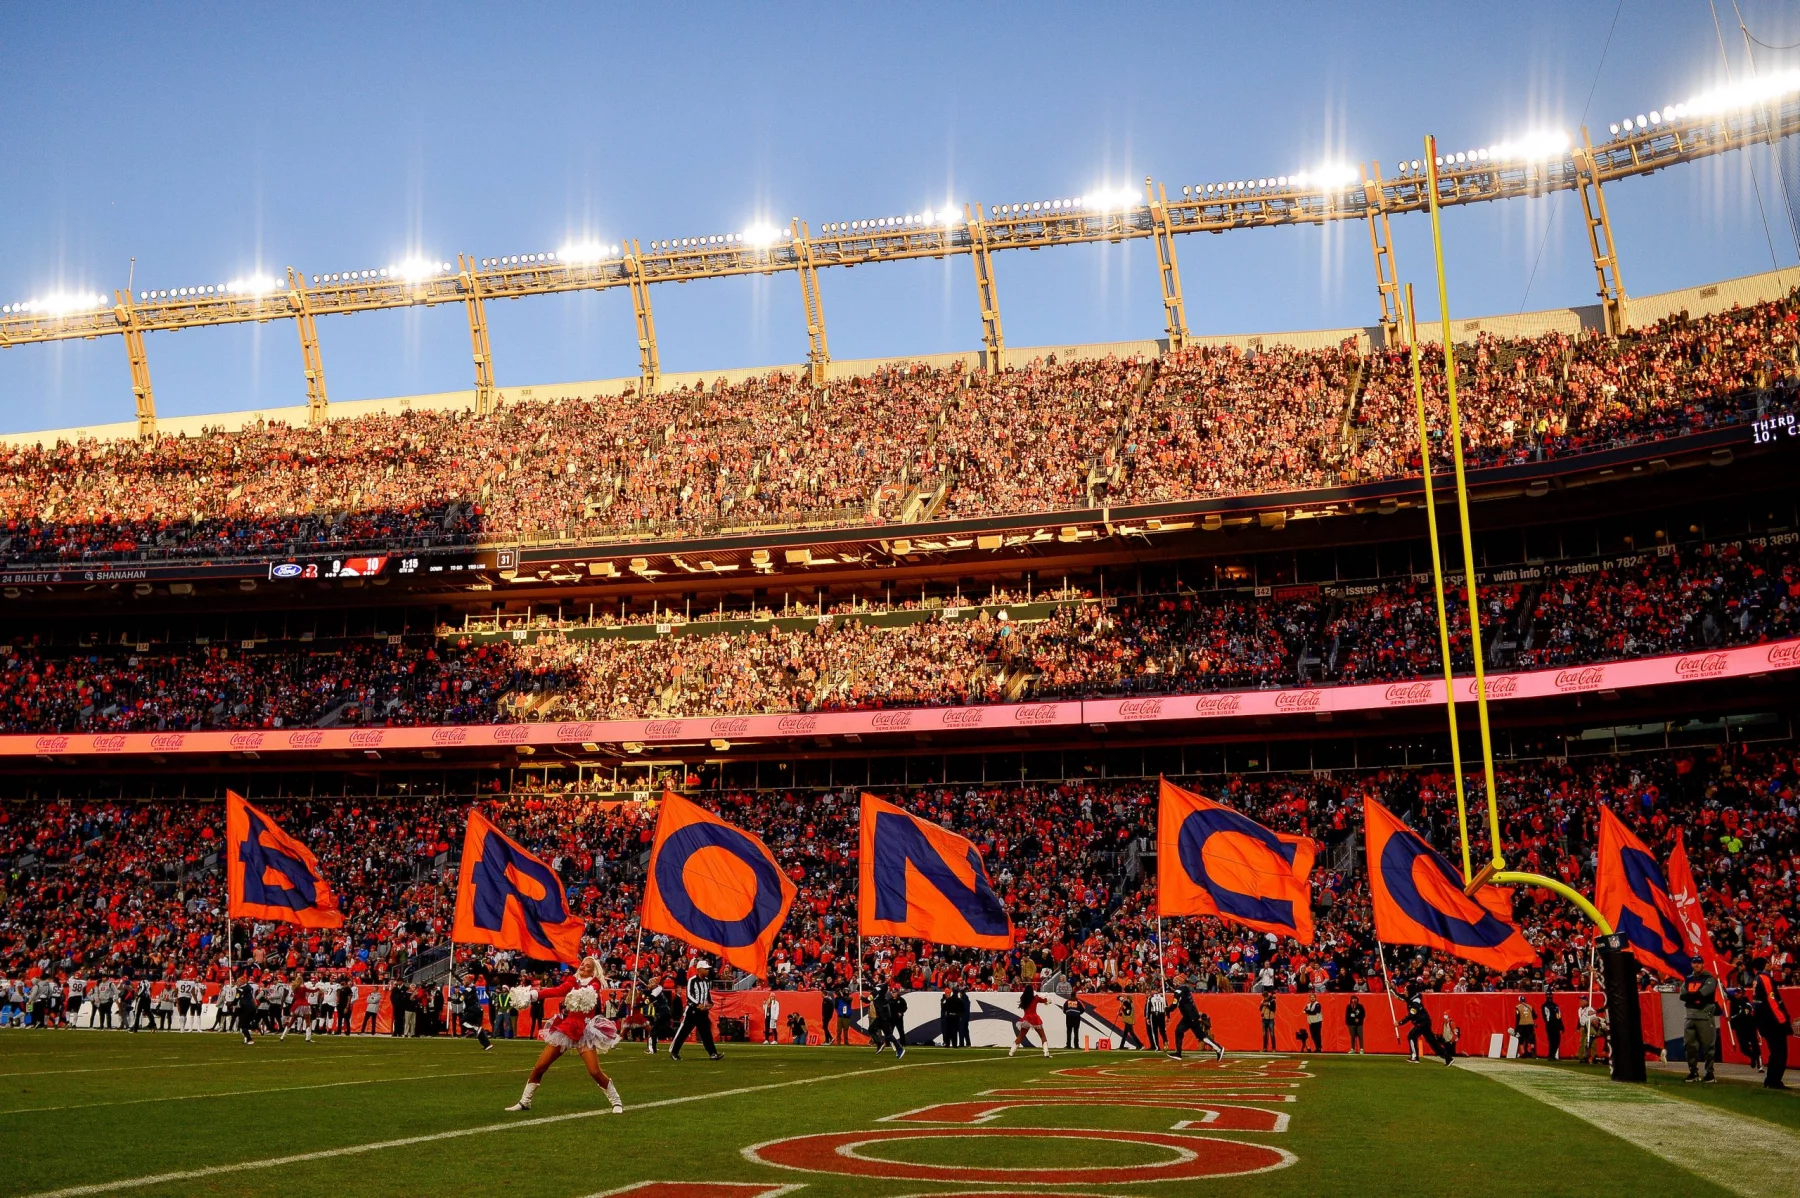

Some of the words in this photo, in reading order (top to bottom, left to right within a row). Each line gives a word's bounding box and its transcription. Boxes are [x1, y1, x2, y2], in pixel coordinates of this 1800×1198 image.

[1751, 414, 1795, 432] THIRD
[366, 558, 379, 570] 10
[402, 558, 418, 569] 1:15
[14, 574, 49, 582] BAILEY
[97, 571, 146, 580] SHANAHAN
[1493, 570, 1517, 581] with
[1519, 568, 1540, 579] info
[1555, 563, 1599, 575] lcation
[1345, 585, 1378, 595] issues
[1675, 653, 1730, 673] Coca-Cola
[1554, 668, 1603, 686] Coca-Cola
[1385, 683, 1433, 699] Coca-Cola
[1196, 695, 1241, 710] Coca-Cola
[1275, 691, 1322, 706] Coca-Cola
[1015, 705, 1058, 719] Coca-Cola
[1119, 699, 1163, 714] Coca-Cola
[872, 712, 912, 726] Coca-Cola
[942, 708, 984, 722] Coca-Cola
[645, 721, 683, 734] Coca-Cola
[711, 718, 749, 732] Coca-Cola
[778, 716, 817, 729] Coca-Cola
[349, 730, 385, 743] Coca-Cola
[432, 728, 468, 740] Coca-Cola
[494, 726, 530, 739] Coca-Cola
[557, 724, 594, 737] Coca-Cola
[36, 736, 69, 748] Coca-Cola
[93, 736, 127, 748] Coca-Cola
[151, 734, 185, 746] Coca-Cola
[230, 733, 265, 745] Coca-Cola
[289, 732, 324, 744] Coca-Cola
[238, 806, 318, 911] B
[472, 830, 567, 950] R
[656, 822, 782, 948] O
[874, 812, 1010, 936] N
[1178, 808, 1298, 928] C
[181, 985, 191, 993] 92
